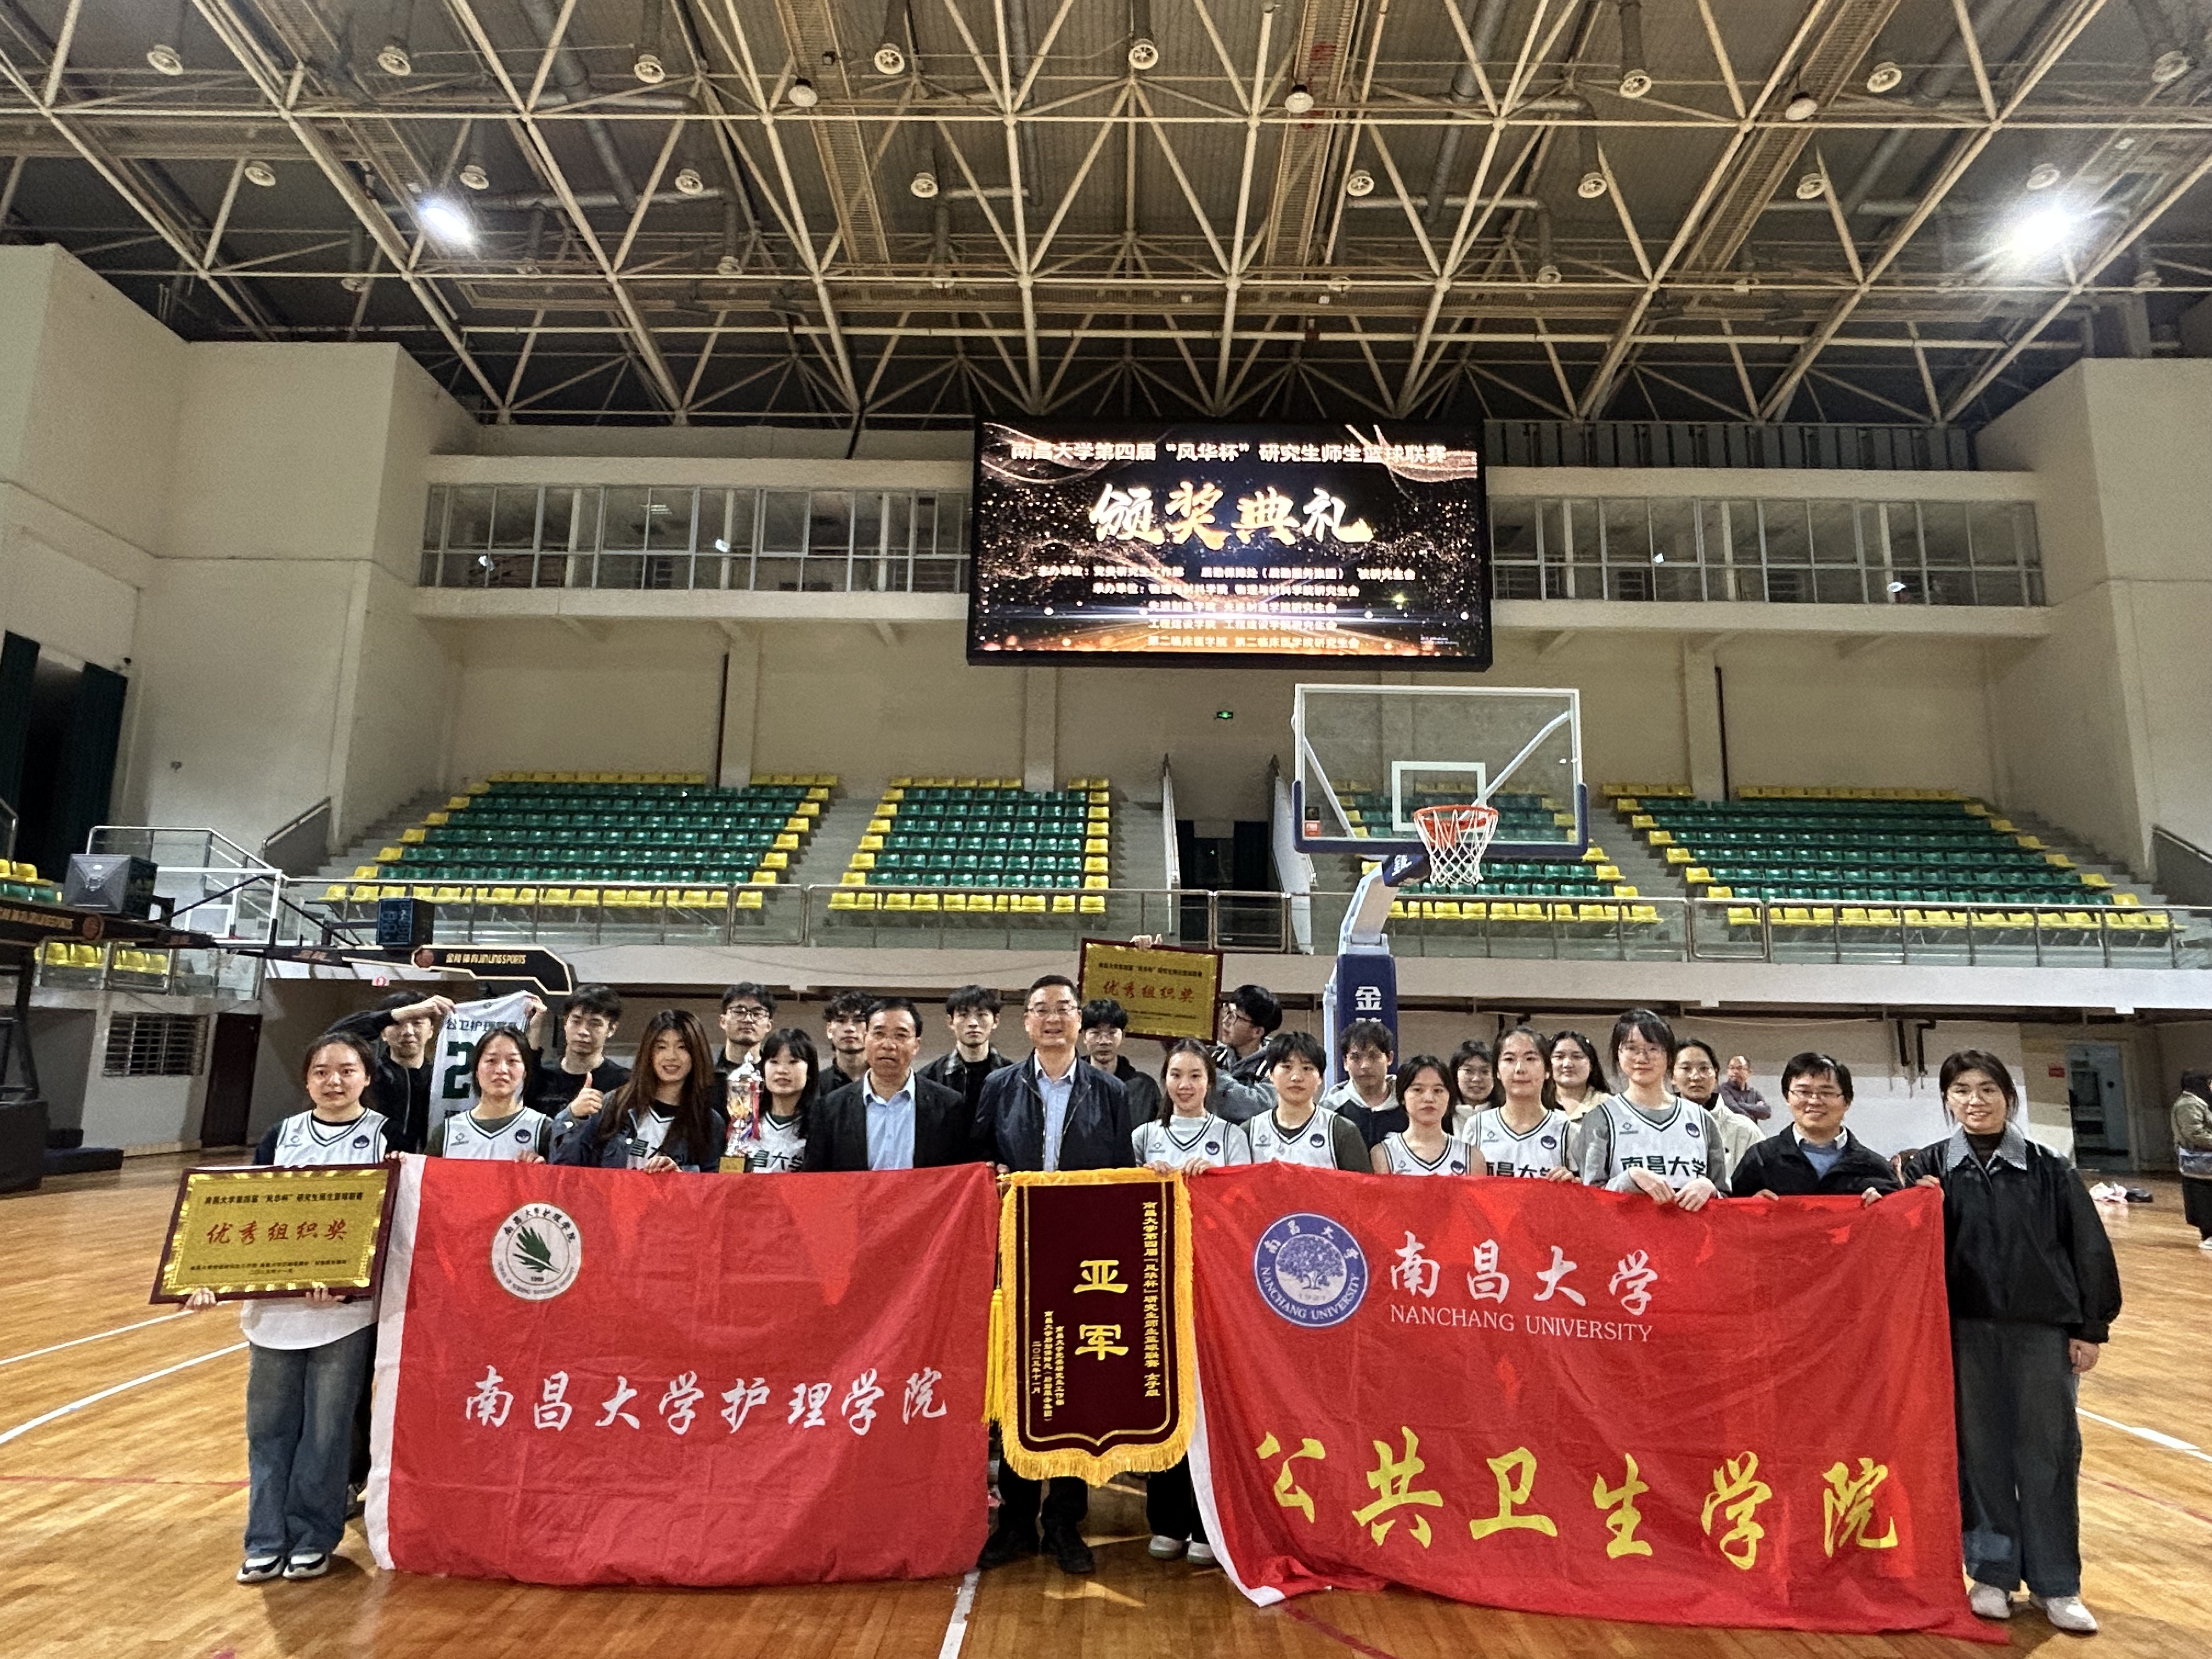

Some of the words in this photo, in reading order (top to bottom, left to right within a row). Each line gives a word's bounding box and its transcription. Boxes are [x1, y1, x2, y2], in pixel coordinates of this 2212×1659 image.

[1090, 481, 1374, 550] 颁奖典礼
[1103, 980, 1195, 1003] 优秀组织奖
[206, 1218, 348, 1245] 优秀组织奖
[1263, 1219, 1359, 1260] 南昌大学
[1261, 1266, 1307, 1319] NANCHANG
[1311, 1273, 1360, 1320] UNIVERSITY
[1390, 1229, 1659, 1316] 南昌大学
[1073, 1260, 1129, 1361] 亚军
[1391, 1304, 1515, 1331] NANCHANG
[1526, 1316, 1654, 1342] UNIVERSITY
[465, 1364, 948, 1436] 南昌大学护理学院
[1255, 1425, 1899, 1570] 公共卫生学院
